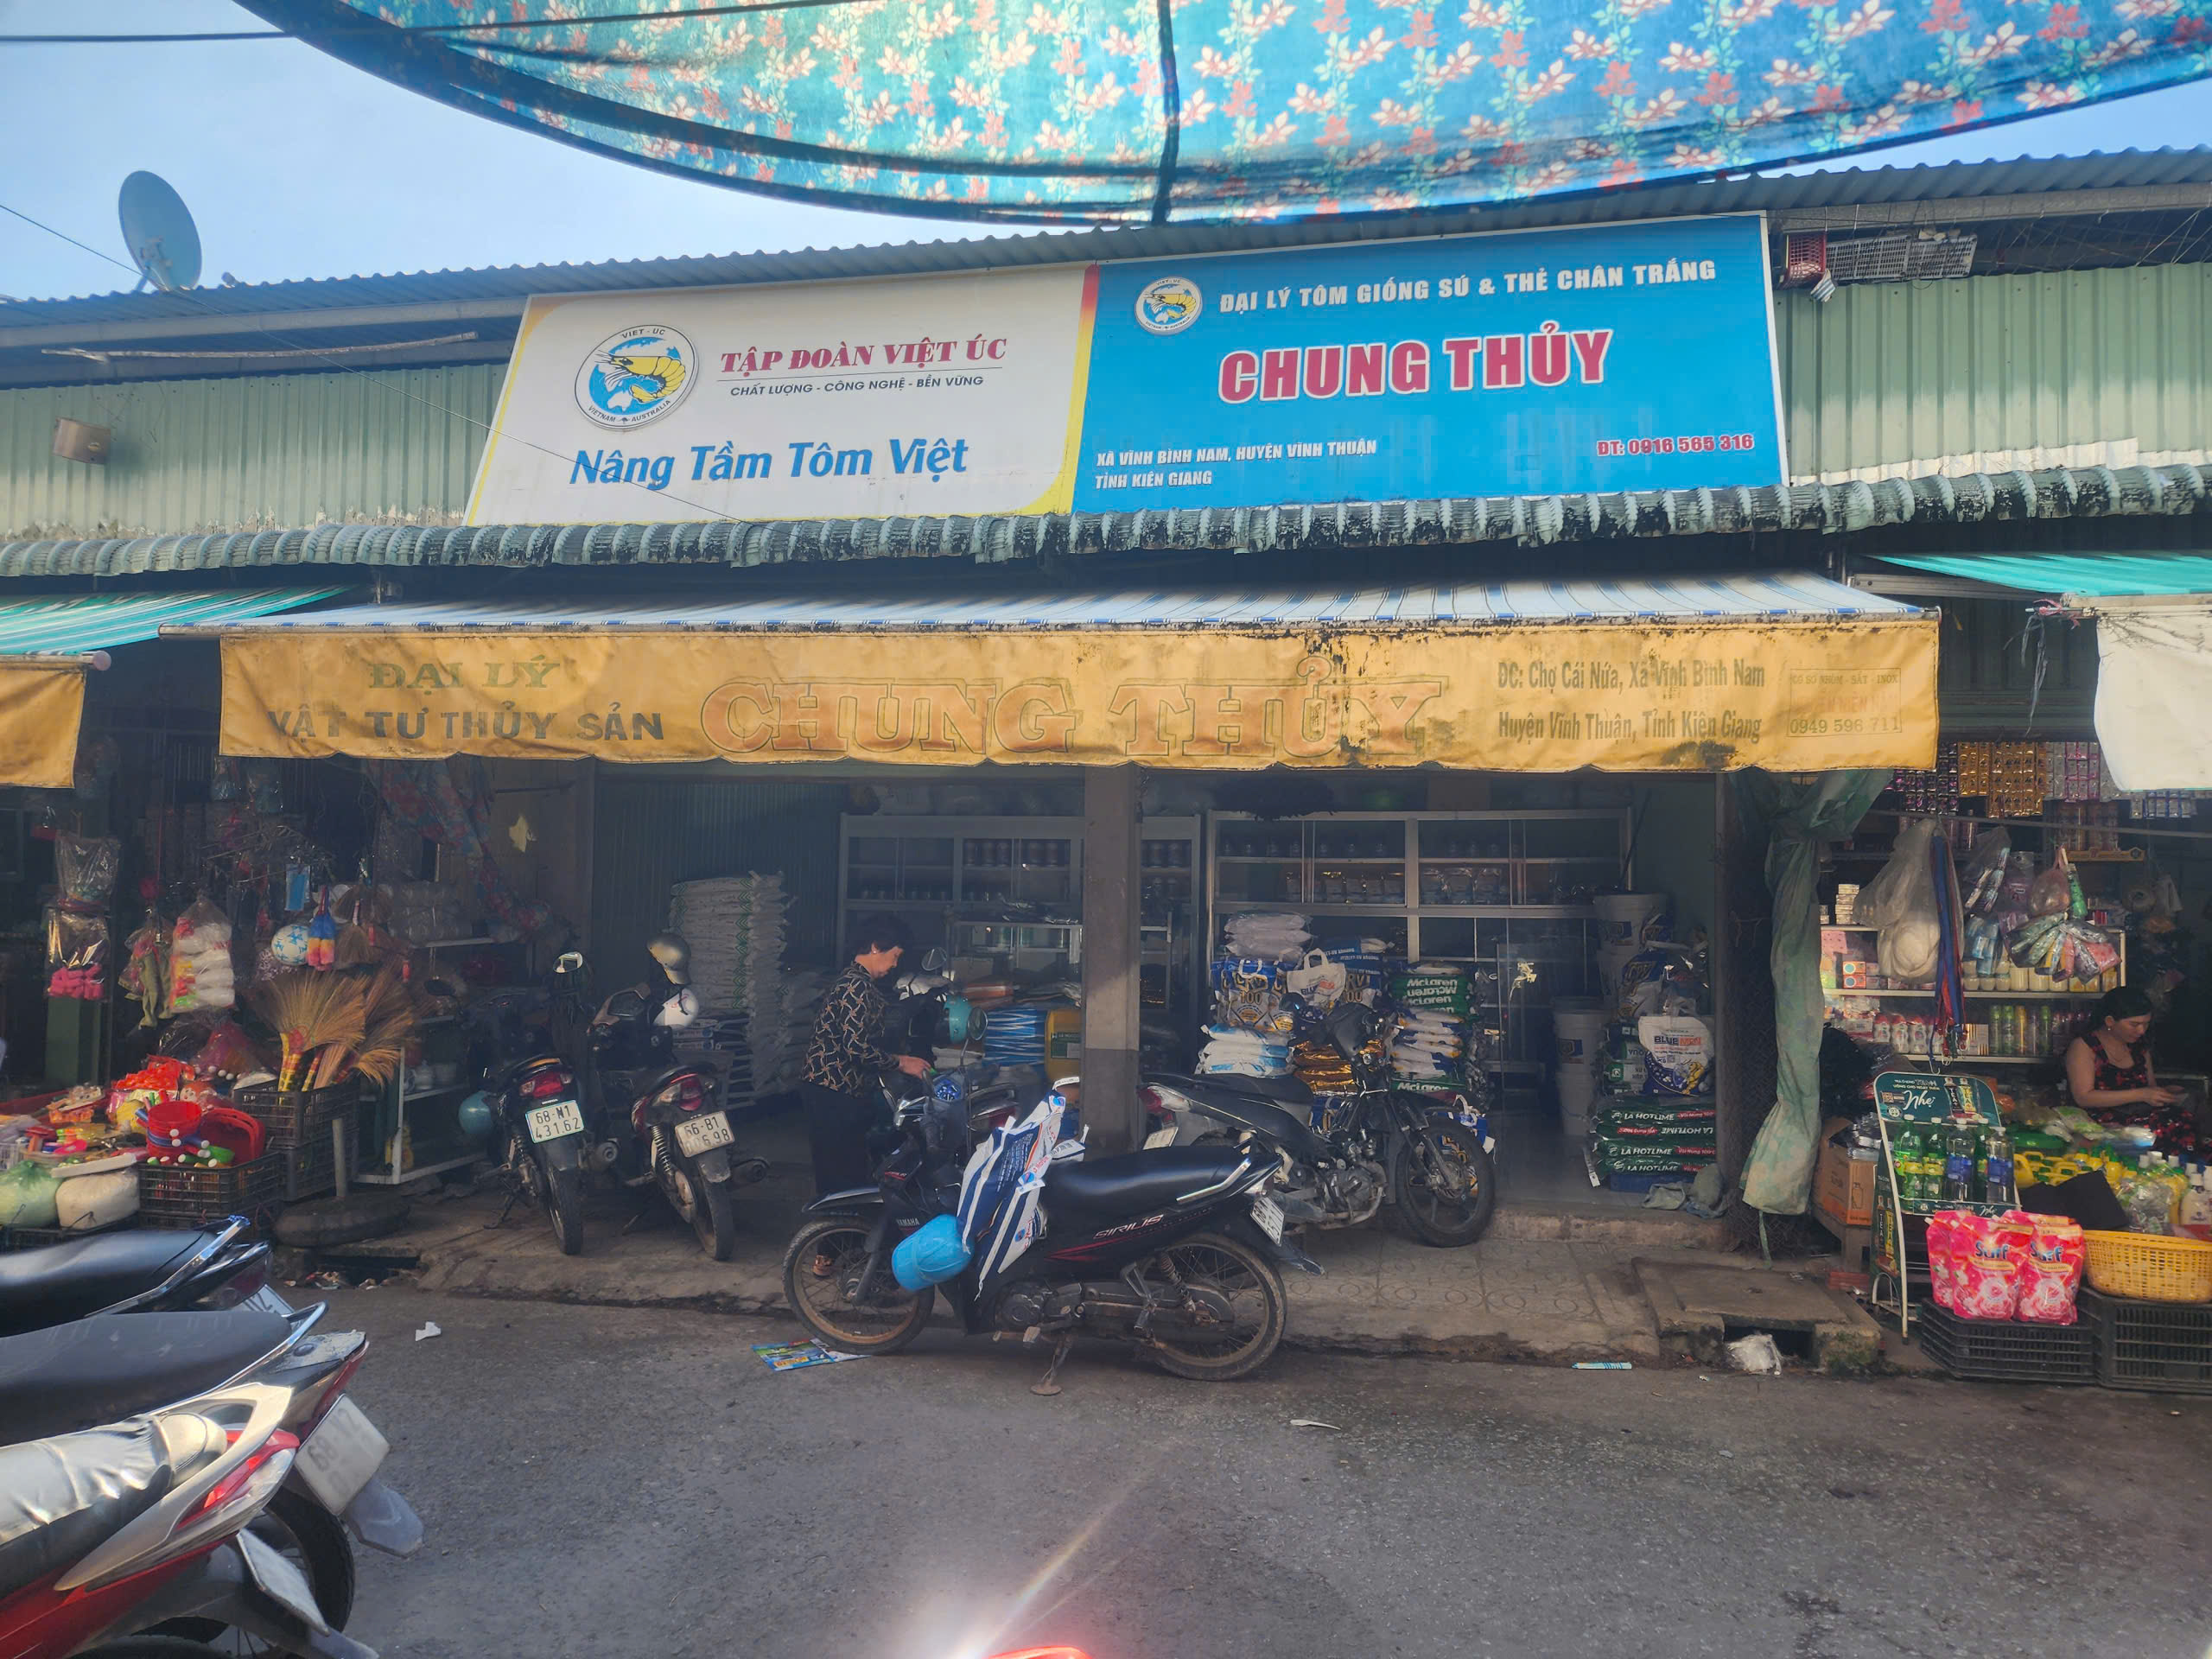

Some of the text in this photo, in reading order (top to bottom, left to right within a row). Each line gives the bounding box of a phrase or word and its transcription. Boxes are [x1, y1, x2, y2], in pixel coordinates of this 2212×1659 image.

[1219, 257, 1716, 315] ĐẠI LÝ TÔM GIỐNG SÚ & THẺ CHÂN TRẮNG
[621, 328, 645, 339] VIET
[721, 334, 1007, 378] TẬP ĐOÀN VIỆT ÚC
[1217, 321, 1613, 404] CHUNG THỦY
[730, 382, 766, 396] CHẤT
[768, 383, 813, 397] LƯỢNG
[823, 380, 864, 392] CÔNG
[868, 377, 906, 391] NGHỆ
[916, 374, 941, 388] BỀN
[945, 375, 983, 386] VỮNG
[588, 399, 671, 423] VIETNAM AUSTRALIA
[1157, 448, 1192, 465] BÌNH
[1196, 447, 1231, 463] NAM,
[1236, 442, 1282, 461] HUYỆN
[1327, 437, 1377, 457] THUẬN
[1597, 433, 1755, 456] ĐT: 0916 565 316
[569, 437, 969, 491] Nâng Tầm Tôm Việt
[1095, 470, 1212, 489] TỈNH KIÊN GIANG
[368, 654, 560, 696] ĐẠI LÝ
[1497, 661, 1523, 689] ĐC:
[1529, 662, 1556, 694] Chợ
[1561, 661, 1585, 690] Cái
[1630, 660, 1649, 688] Xã
[1654, 658, 1688, 687] Vĩnh
[1693, 658, 1728, 687] Bình
[1733, 658, 1765, 687] Nam
[1877, 674, 1898, 684] INOX
[700, 656, 1446, 758] CHUNG THỦY
[267, 701, 664, 744] VẬT TƯ THỦY SẢN
[1498, 711, 1544, 745] Huyện
[1549, 711, 1580, 741] Vĩnh
[1585, 709, 1637, 744] Thuận,
[1642, 708, 1675, 738] Tỉnh
[1721, 709, 1762, 744] Giang
[1789, 716, 1899, 734] 0949 596 711
[1407, 978, 1458, 987] McLaren
[1240, 989, 1262, 1005] 100
[1654, 1036, 1679, 1046] BLUE
[1902, 1090, 1936, 1110] Nhẹ
[536, 1117, 581, 1139] 431.62
[1093, 1213, 1164, 1240] SIRIUS
[1975, 1241, 2009, 1260] Surf
[2031, 1242, 2063, 1262] Surf
